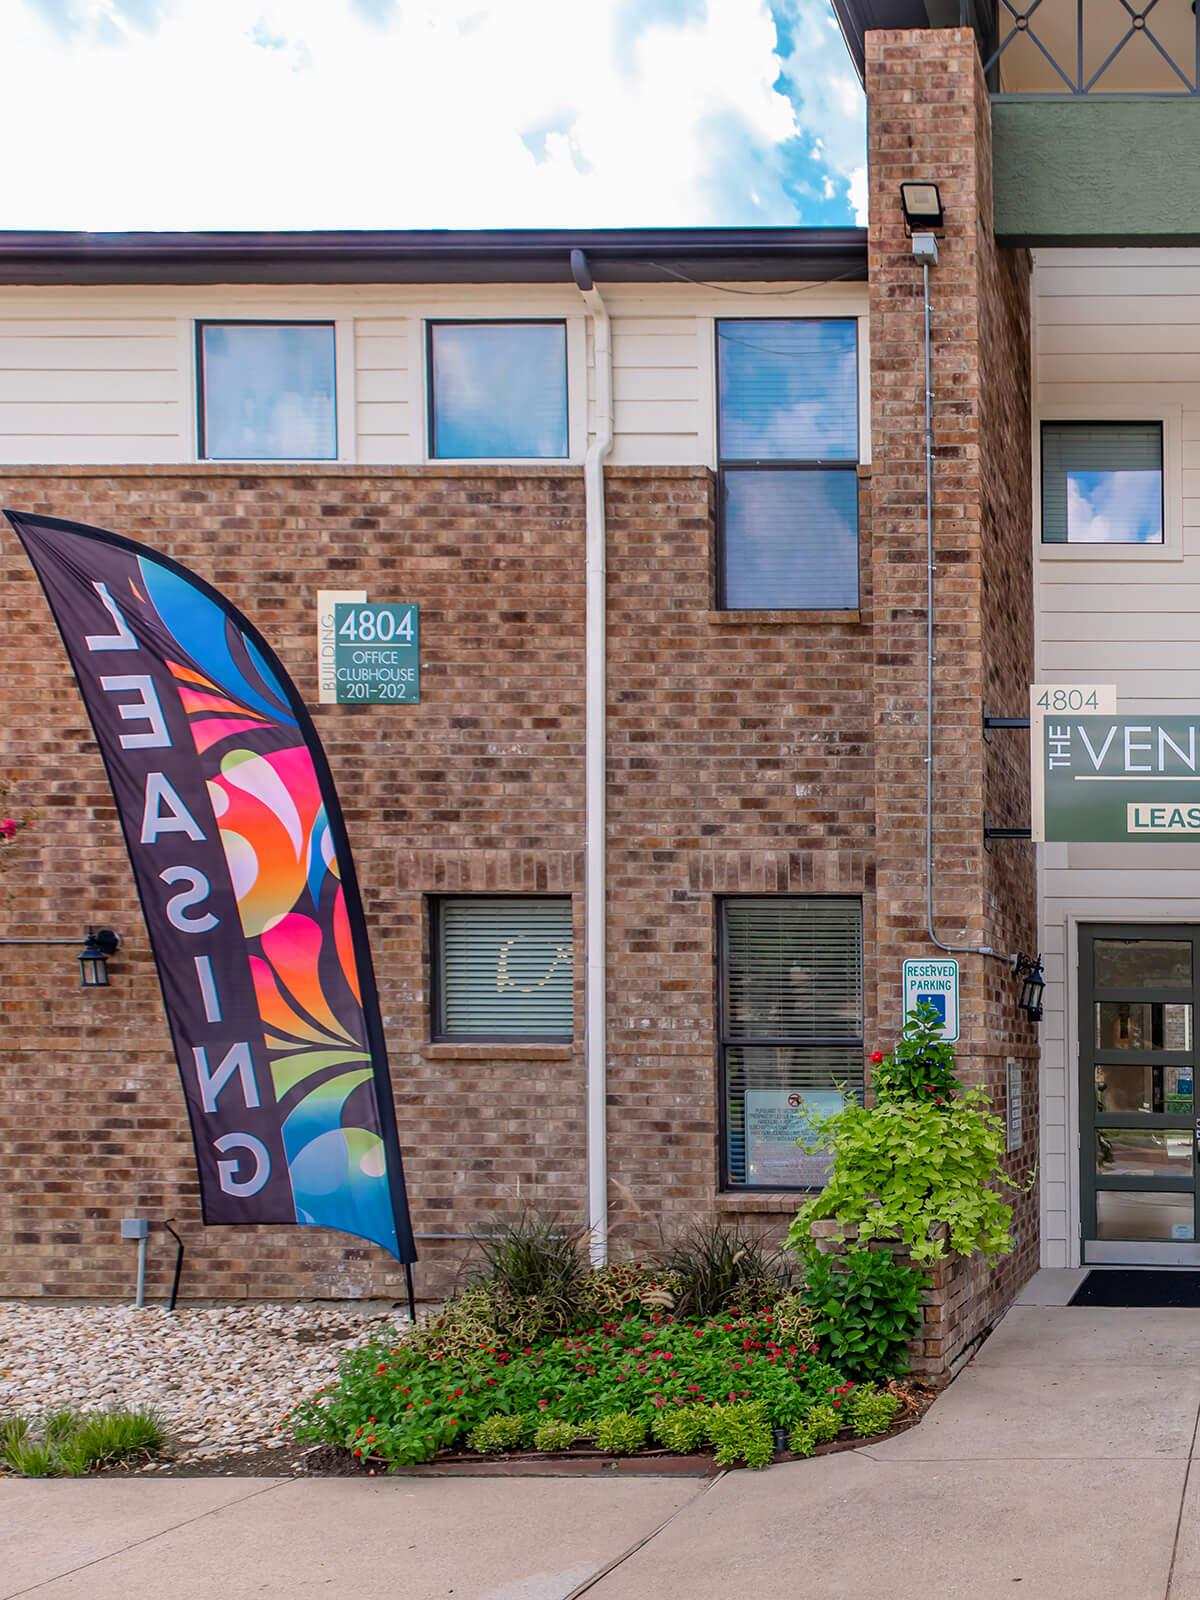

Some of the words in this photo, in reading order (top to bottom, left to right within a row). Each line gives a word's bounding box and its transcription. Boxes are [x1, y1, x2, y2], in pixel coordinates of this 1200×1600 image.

[338, 610, 414, 641] 4804
[321, 614, 336, 691] BUILDING
[352, 651, 398, 664] OFFICE
[336, 668, 415, 681] CLUBHOUSE
[346, 684, 406, 698] 201-202
[1036, 689, 1100, 711] 4804
[1048, 725, 1071, 770] THE
[907, 966, 955, 977] RESERVED
[910, 980, 952, 991] PARKING
